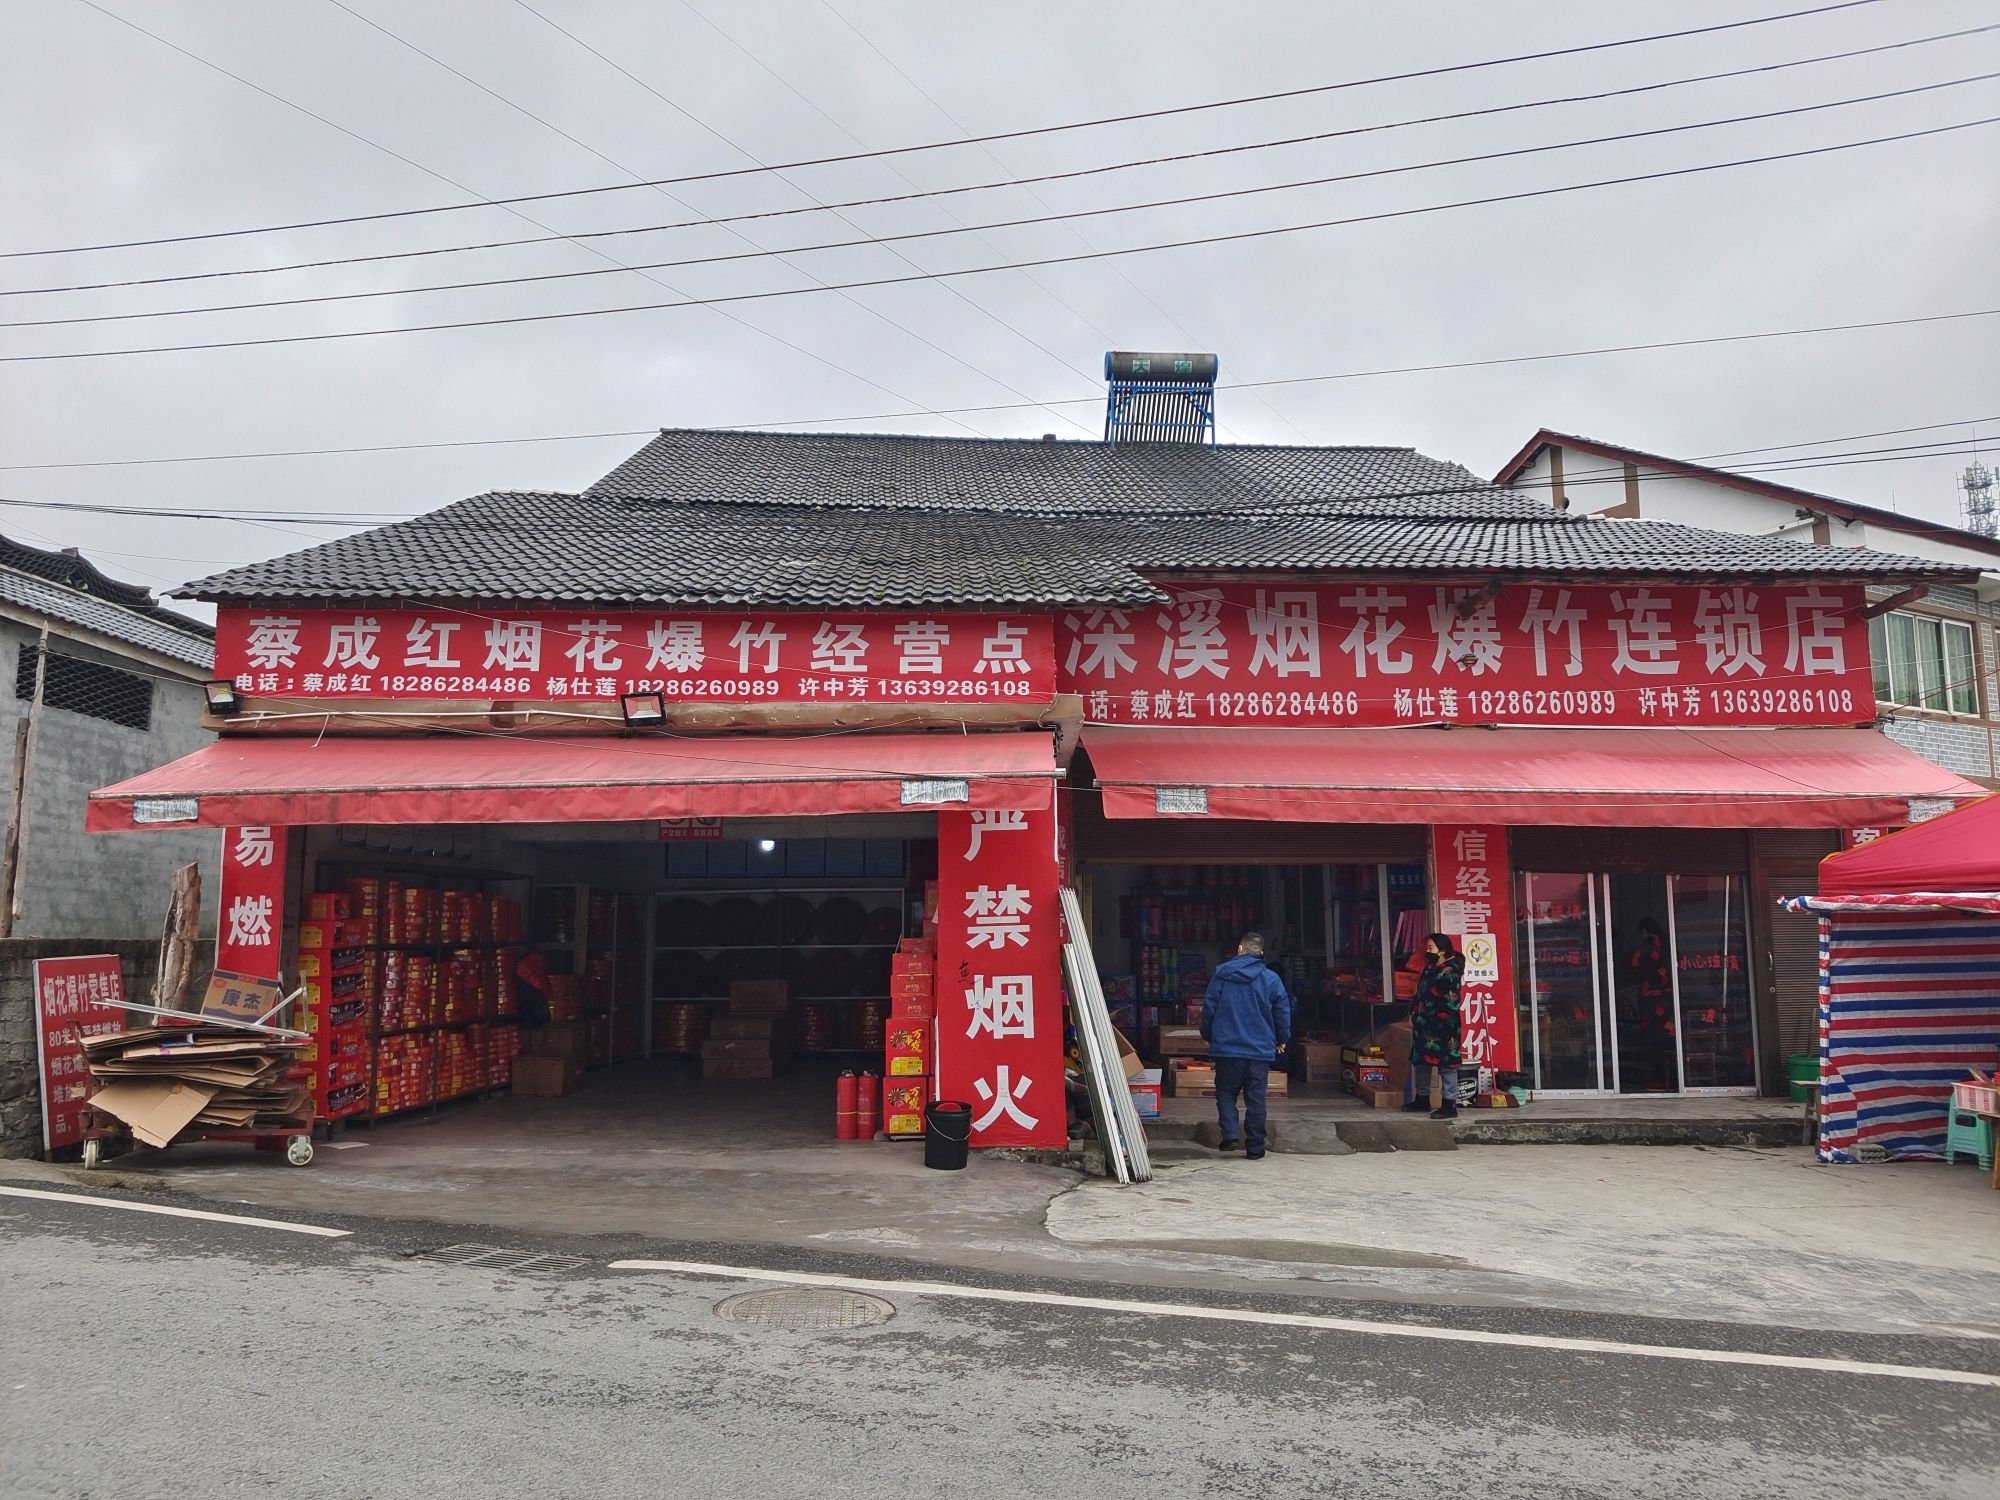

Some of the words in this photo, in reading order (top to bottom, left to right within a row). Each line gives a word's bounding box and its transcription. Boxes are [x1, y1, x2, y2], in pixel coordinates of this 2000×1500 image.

[245, 616, 1032, 674] 蔡成红烟花爆竹经营点
[1064, 586, 1846, 679] 深溪烟花爆竹连锁店
[381, 675, 531, 694] 18286284486
[546, 677, 617, 697] 杨仕莲
[625, 679, 779, 696] 18286260989
[798, 678, 869, 698] 许中芳
[877, 679, 1031, 697] 13639286108
[1206, 691, 1359, 718] 18286284486
[1394, 688, 1459, 718] 杨仕莲
[1467, 689, 1615, 715] 18286260989
[1638, 687, 1701, 718] 许中芳
[1710, 689, 1853, 714] 13639286108
[228, 826, 274, 946] 易燃
[44, 970, 120, 1016] 烟花爆竹零售店
[963, 810, 1039, 1133] 严禁烟火
